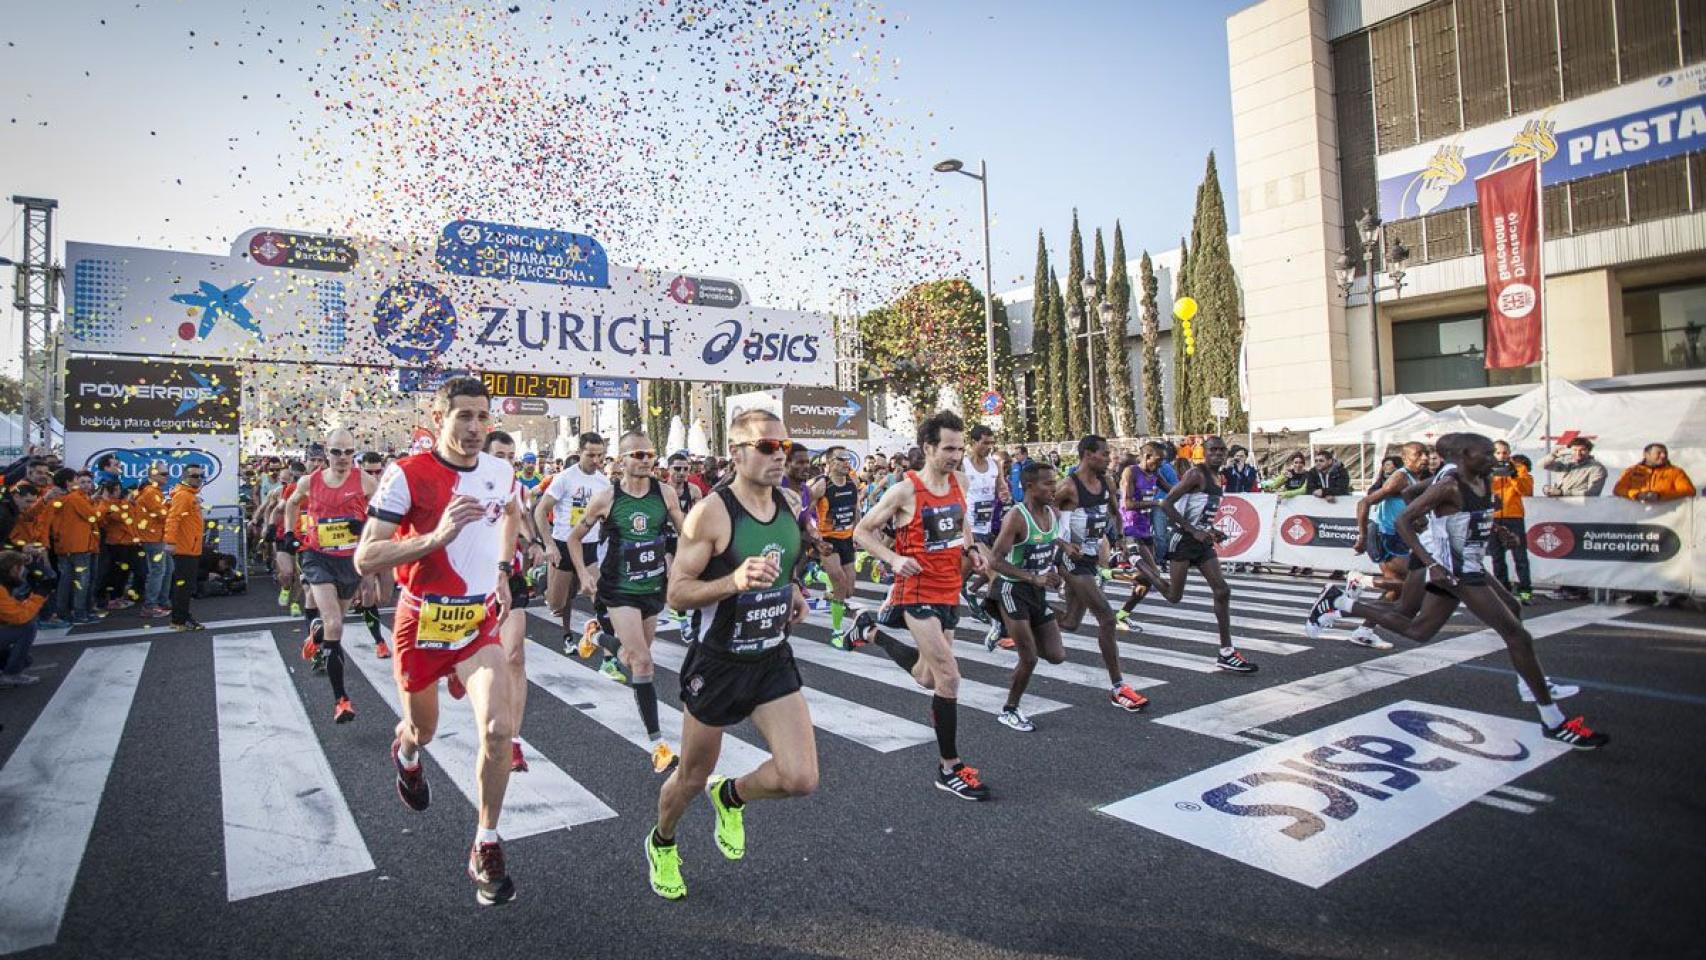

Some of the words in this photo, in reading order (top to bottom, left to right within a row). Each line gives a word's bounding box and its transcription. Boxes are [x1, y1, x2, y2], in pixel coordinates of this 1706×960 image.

[1568, 105, 1706, 165] PASTA
[484, 231, 540, 247] ZURICH
[510, 264, 587, 282] BARCELONA
[475, 306, 671, 357] ZURICH
[743, 329, 819, 364] asics
[80, 383, 218, 400] POWERADE
[80, 415, 121, 427] bebida
[125, 417, 149, 428] para
[152, 416, 217, 429] deportistas
[939, 517, 954, 531] 63
[1583, 531, 1644, 541] Ajuntament
[1646, 531, 1659, 540] de
[1583, 541, 1659, 552] Barcelona
[639, 550, 655, 563] 68
[432, 606, 475, 622] Julio
[746, 603, 787, 622] SERGIO
[760, 619, 772, 629] 25
[1201, 734, 1461, 842] asics
